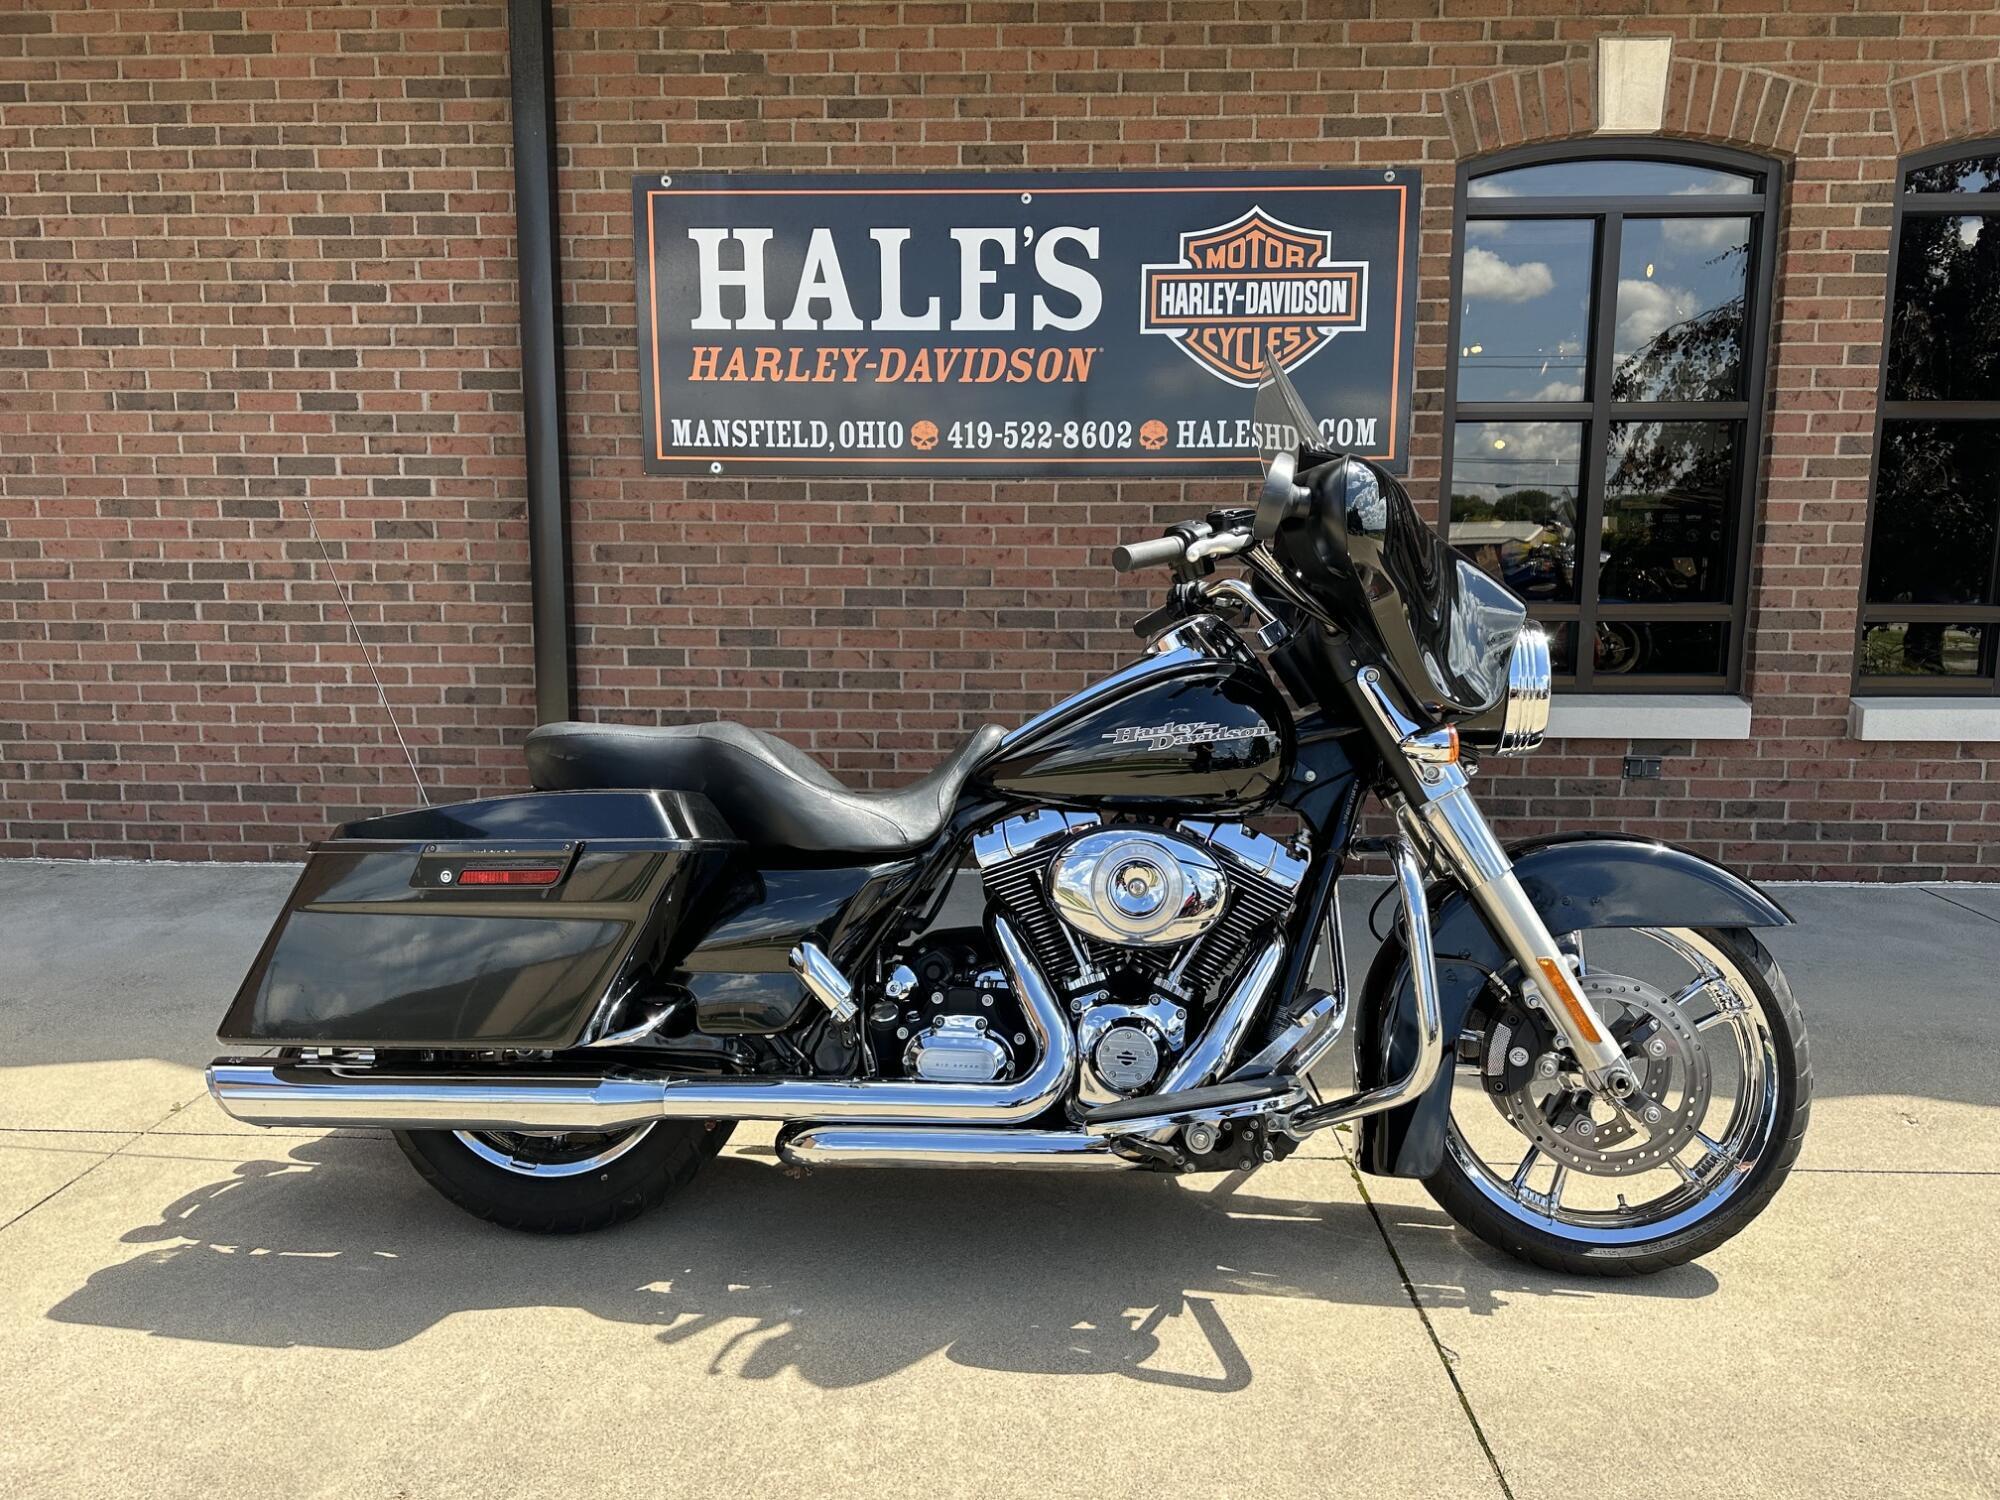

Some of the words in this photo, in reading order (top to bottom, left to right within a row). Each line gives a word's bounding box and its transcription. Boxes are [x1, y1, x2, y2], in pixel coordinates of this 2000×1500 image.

[1205, 230, 1306, 269] MOTOR
[687, 225, 1103, 332] HALE'S
[1160, 279, 1348, 317] HARLEY-DAVIDSON
[687, 346, 1097, 384] HARLEY-DAVIDSON
[1202, 326, 1302, 371] CYCLES
[838, 420, 904, 449] OHIO
[947, 420, 1132, 450] 419-522-8602
[1176, 417, 1378, 451] HALESHDCOM
